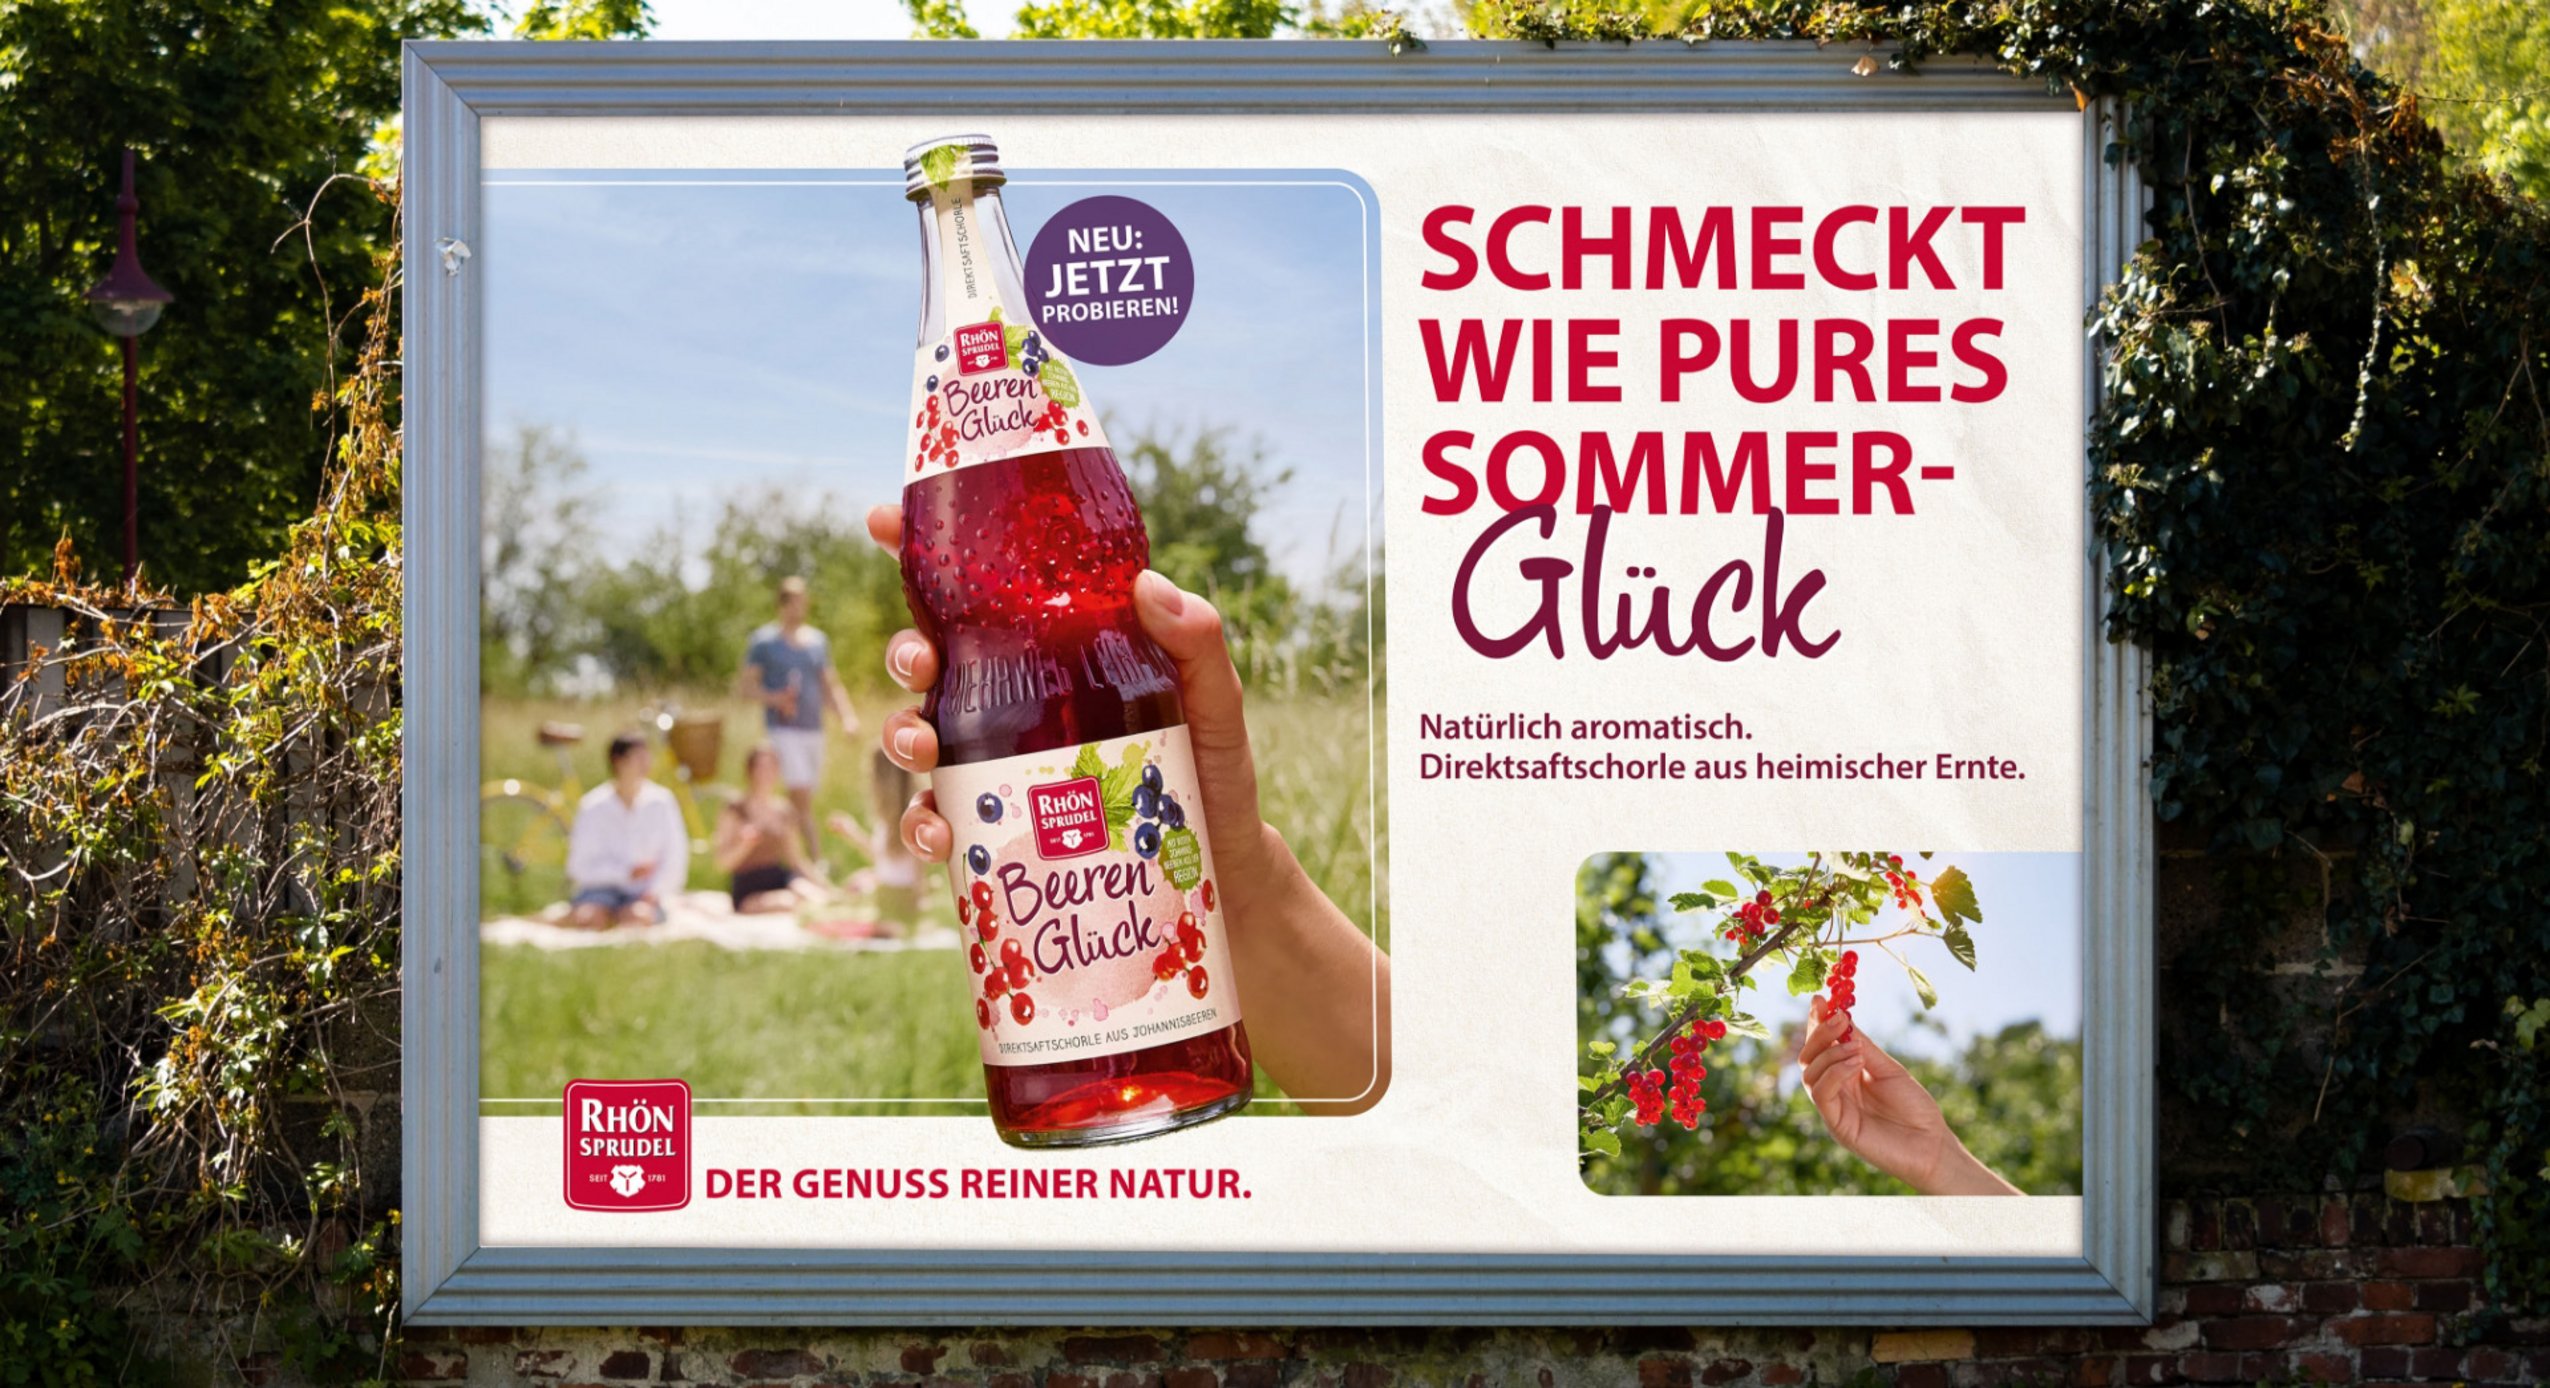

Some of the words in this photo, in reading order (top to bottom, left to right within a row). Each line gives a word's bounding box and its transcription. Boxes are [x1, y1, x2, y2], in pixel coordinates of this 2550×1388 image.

[951, 197, 977, 299] DIREKTSAFTSCHORLE
[1068, 225, 1143, 253] NEU:
[1421, 204, 2026, 291] SCHMECKT
[1045, 256, 1170, 298] JETZT
[1042, 297, 1179, 323] PROBIEREN!
[960, 329, 998, 347] RHÖN
[1418, 318, 1622, 403] WIE
[1660, 317, 2008, 404] PURES
[943, 378, 1038, 417] Beeren
[961, 399, 1039, 441] Glück
[1421, 430, 1955, 516] SOMMER-
[1452, 504, 1842, 663] Glück
[1420, 712, 1562, 740] Natürlich
[1570, 712, 1752, 740] aromatisch.
[1420, 751, 1686, 780] Direktsaftschorle
[1694, 760, 1747, 780] aus
[1756, 752, 1928, 780] heimischer
[1936, 753, 2026, 780] Ernte.
[1038, 790, 1094, 816] RHÖN
[1041, 810, 1097, 830] SPRUDEL
[997, 861, 1155, 926] Beeren
[1033, 900, 1161, 974] Glück
[998, 1033, 1102, 1054] DIREKTSAFTSCHORLE
[1105, 1025, 1129, 1043] AUS
[1133, 1007, 1217, 1038] JOHANNISBEEREN
[581, 1098, 674, 1133] RHÖN
[580, 1137, 676, 1157] SPRUDEL
[589, 1174, 608, 1183] SEIT
[647, 1174, 666, 1183] 1781
[706, 1168, 782, 1199] DER
[792, 1168, 949, 1199] GENUSS
[961, 1168, 1098, 1199] REINER
[1110, 1168, 1253, 1199] NATUR.
